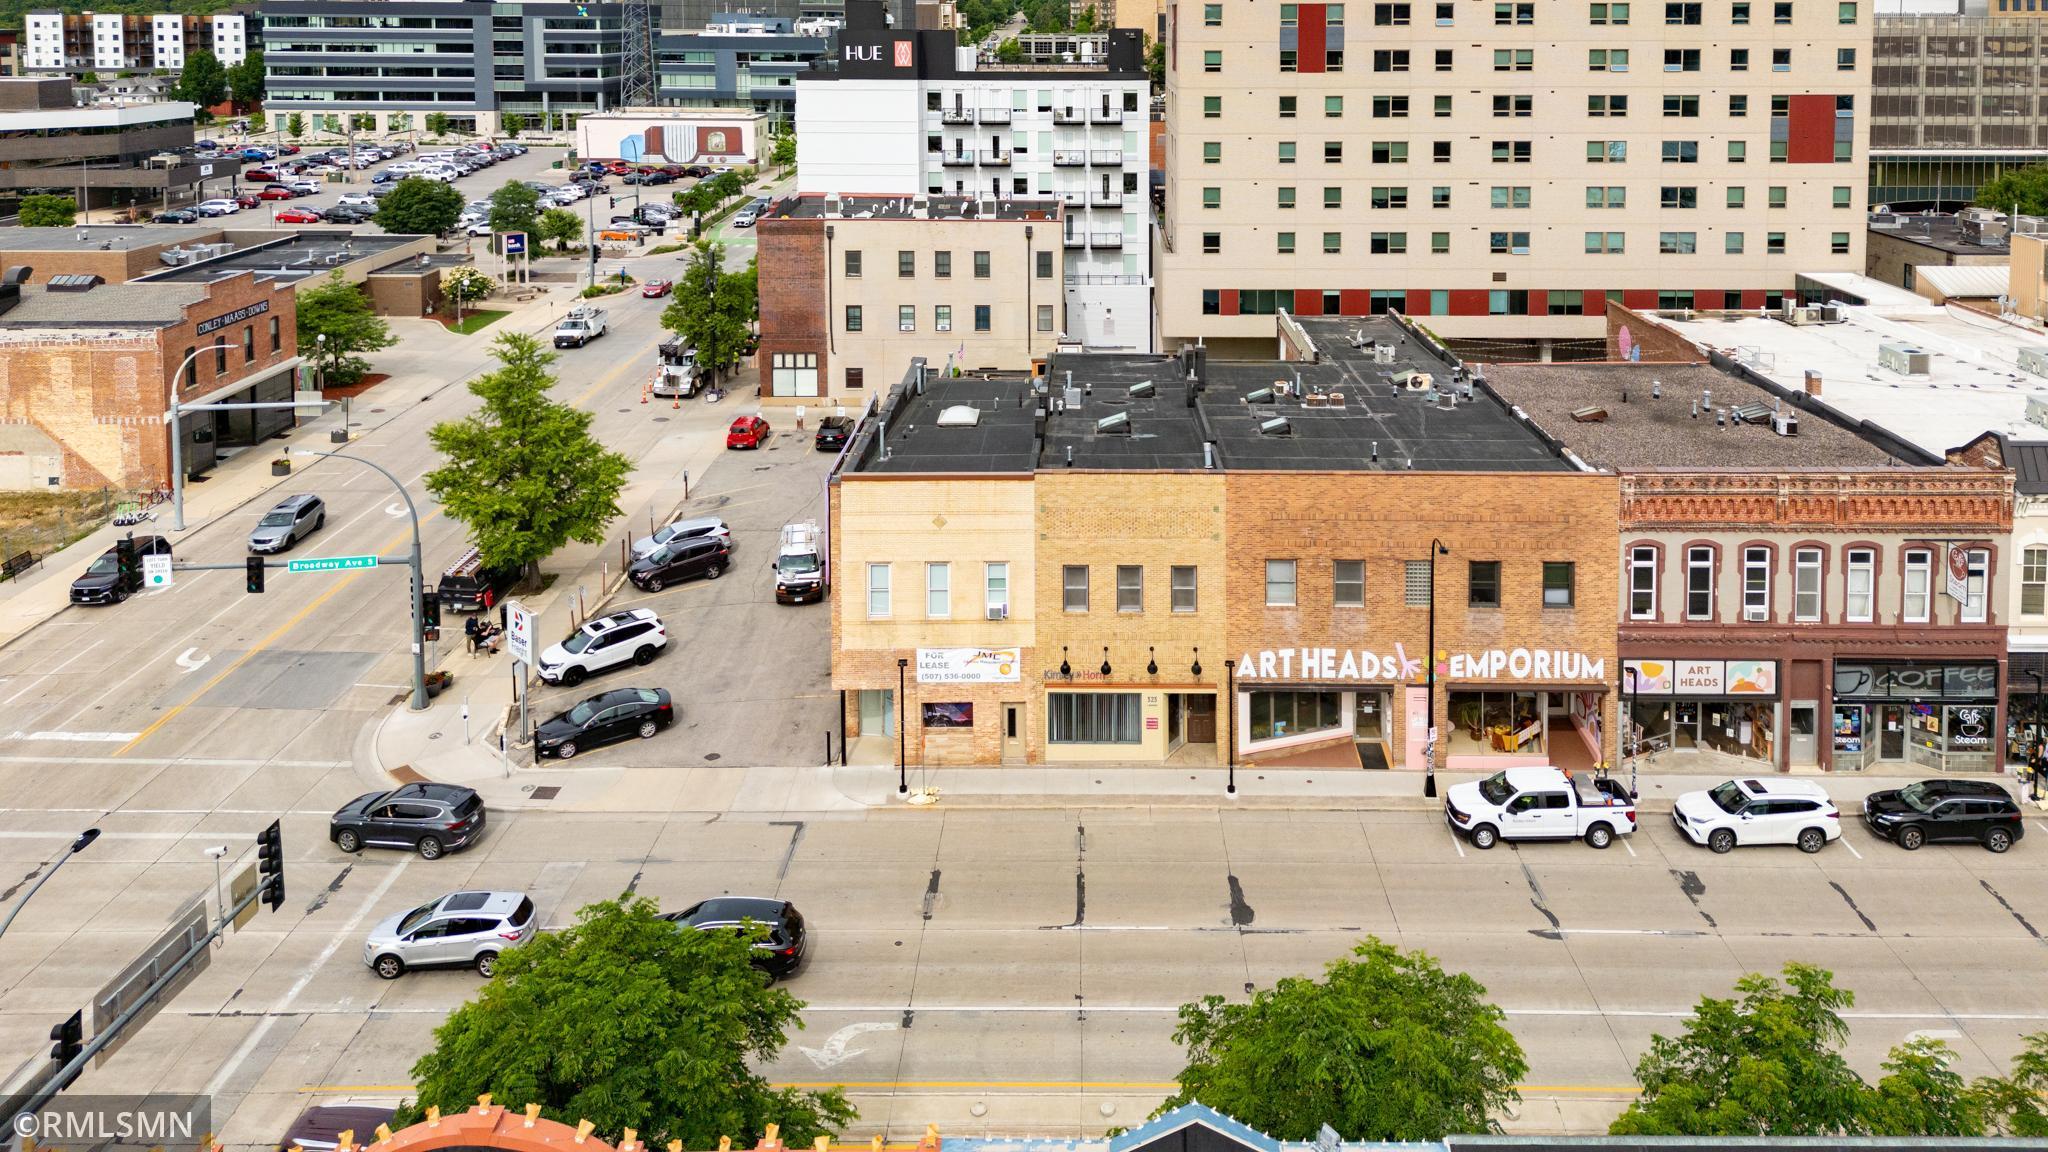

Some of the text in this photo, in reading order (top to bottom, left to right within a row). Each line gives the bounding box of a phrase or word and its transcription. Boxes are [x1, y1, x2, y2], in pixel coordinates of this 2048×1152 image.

[845, 45, 882, 60] HUE
[198, 301, 268, 334] CONLEY MAASS DOWNS
[292, 560, 339, 569] Broadway
[345, 559, 362, 567] Ave
[1236, 649, 1295, 678] ART
[1450, 648, 1604, 679] EMPORIUM
[1688, 666, 1711, 675] ART
[1876, 667, 1994, 686] COFFEE
[1680, 678, 1718, 687] HEADS
[1955, 735, 1987, 744] Steam
